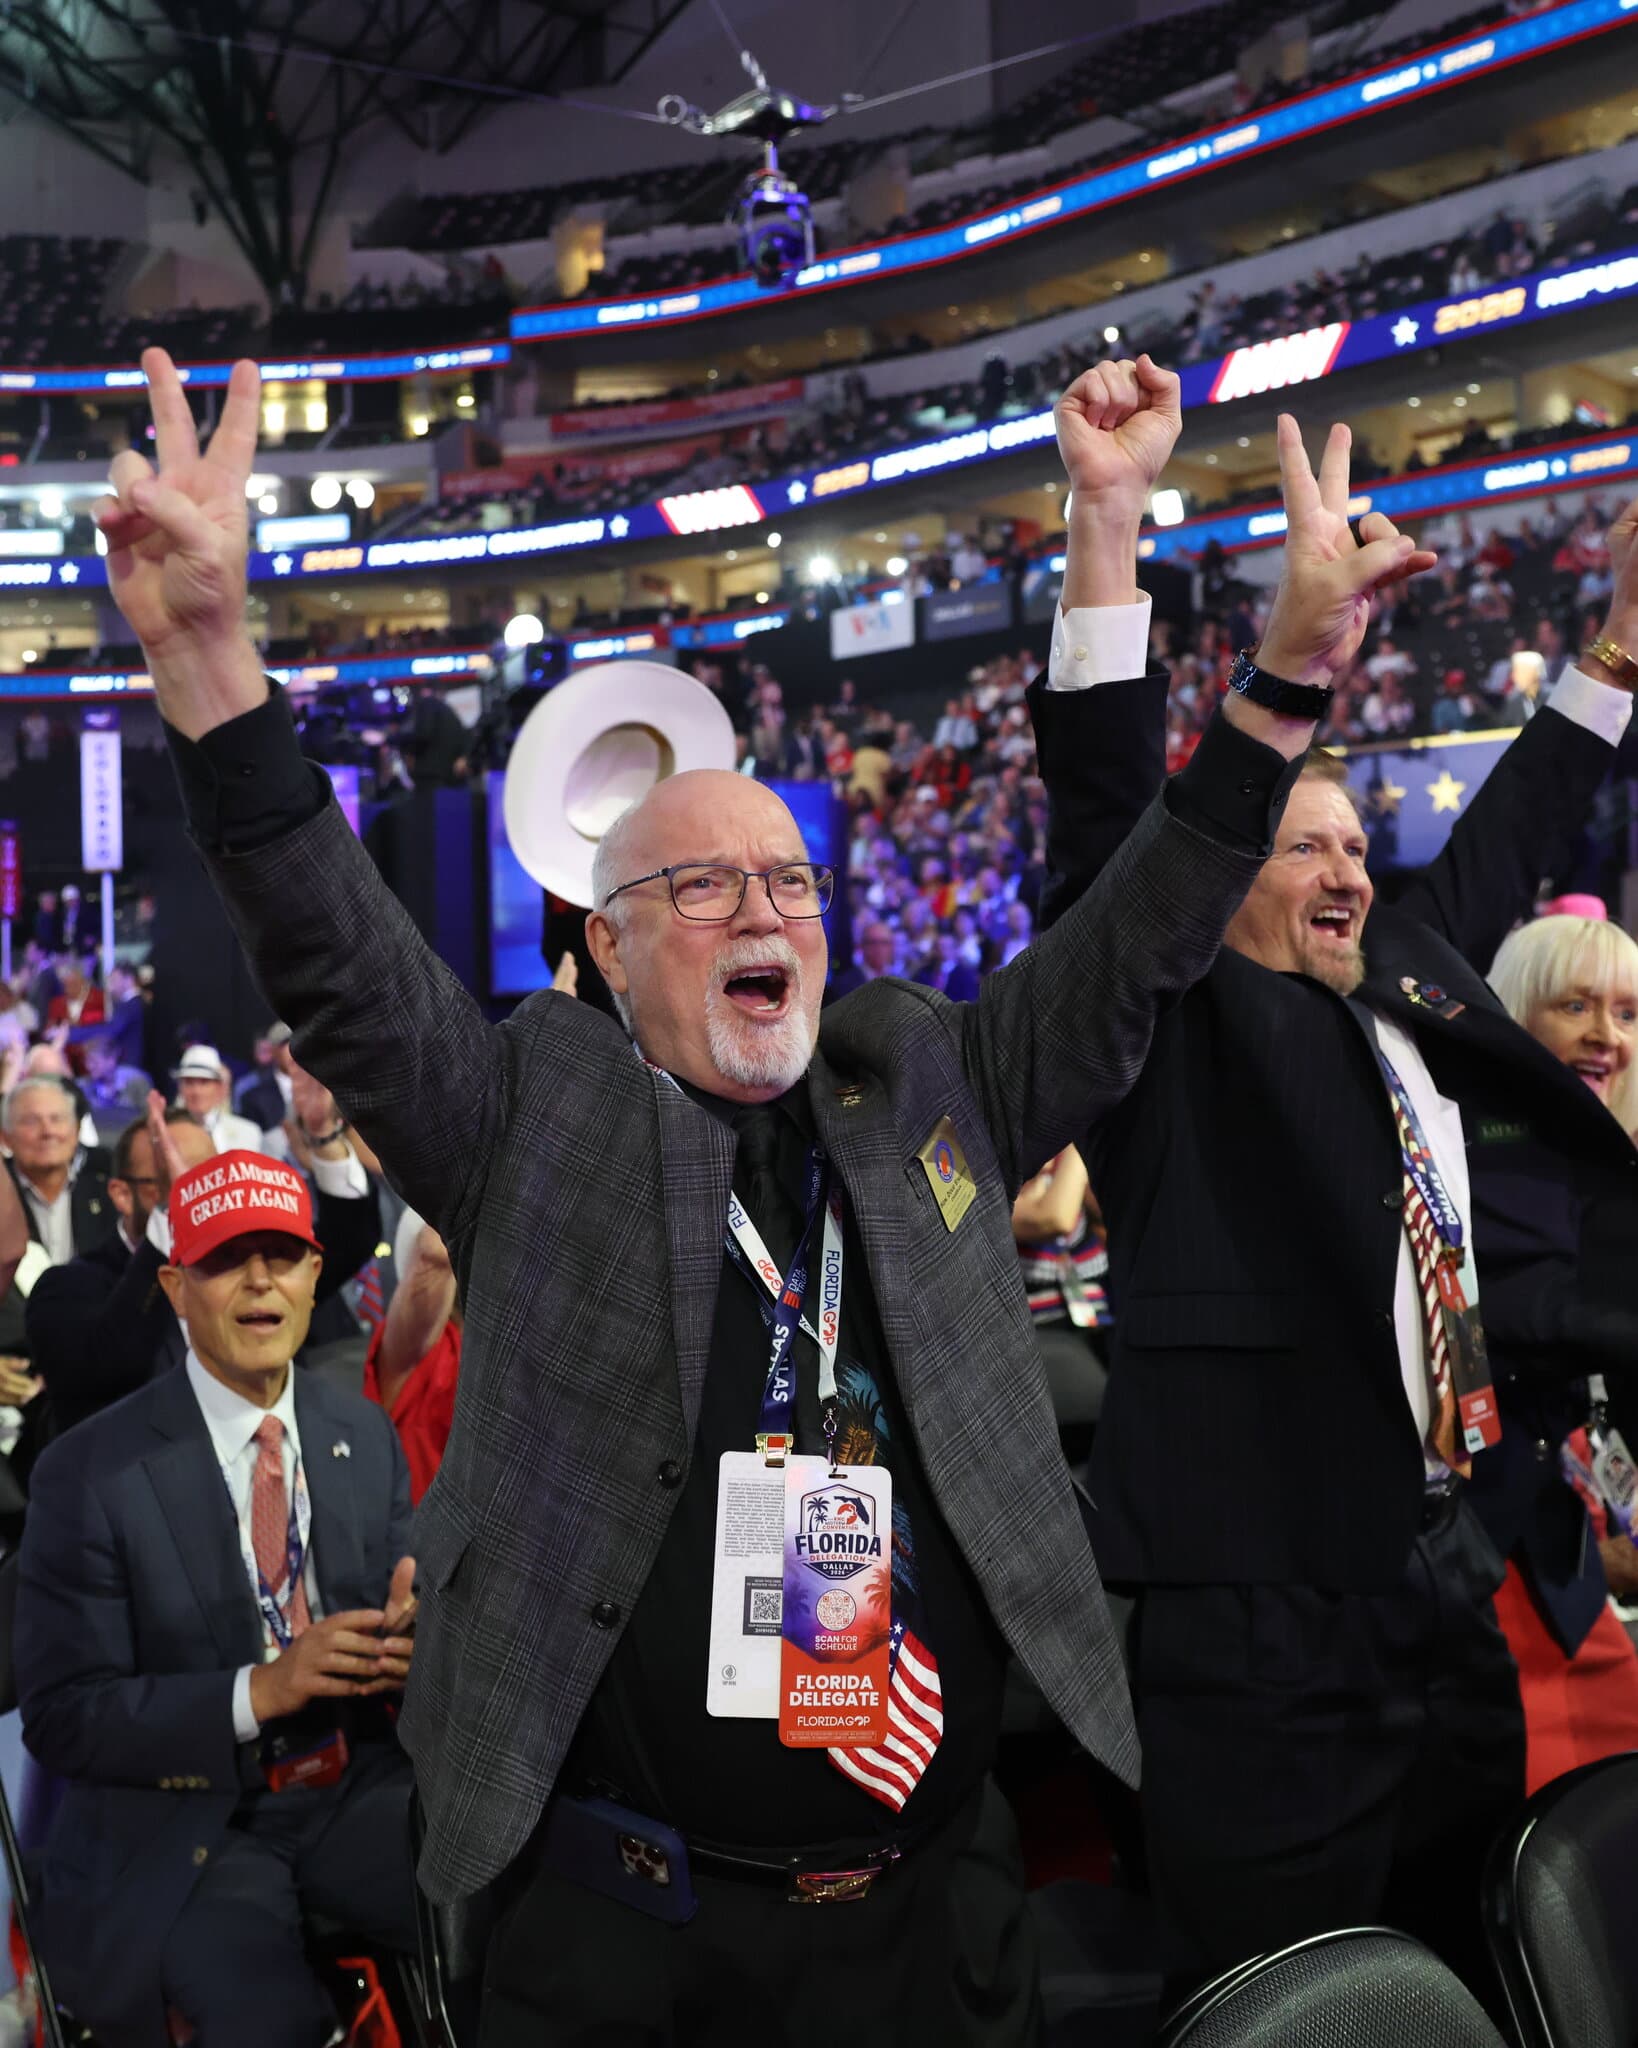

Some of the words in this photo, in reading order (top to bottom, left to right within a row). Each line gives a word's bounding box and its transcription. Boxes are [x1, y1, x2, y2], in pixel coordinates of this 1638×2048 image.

[180, 1167, 226, 1207] MAKE
[228, 1161, 303, 1193] AMERICA
[191, 1189, 245, 1226] GREAT
[249, 1188, 299, 1215] AGAIN
[788, 1268, 802, 1291] DATA
[795, 1533, 881, 1556] FLORIDA
[809, 1553, 866, 1562] DELEGATION
[815, 1635, 840, 1643] SCAN
[841, 1635, 858, 1643] FOR
[815, 1643, 857, 1651] SCHEDULE
[796, 1675, 873, 1690] FLORIDA
[789, 1692, 879, 1706] DELEGATE
